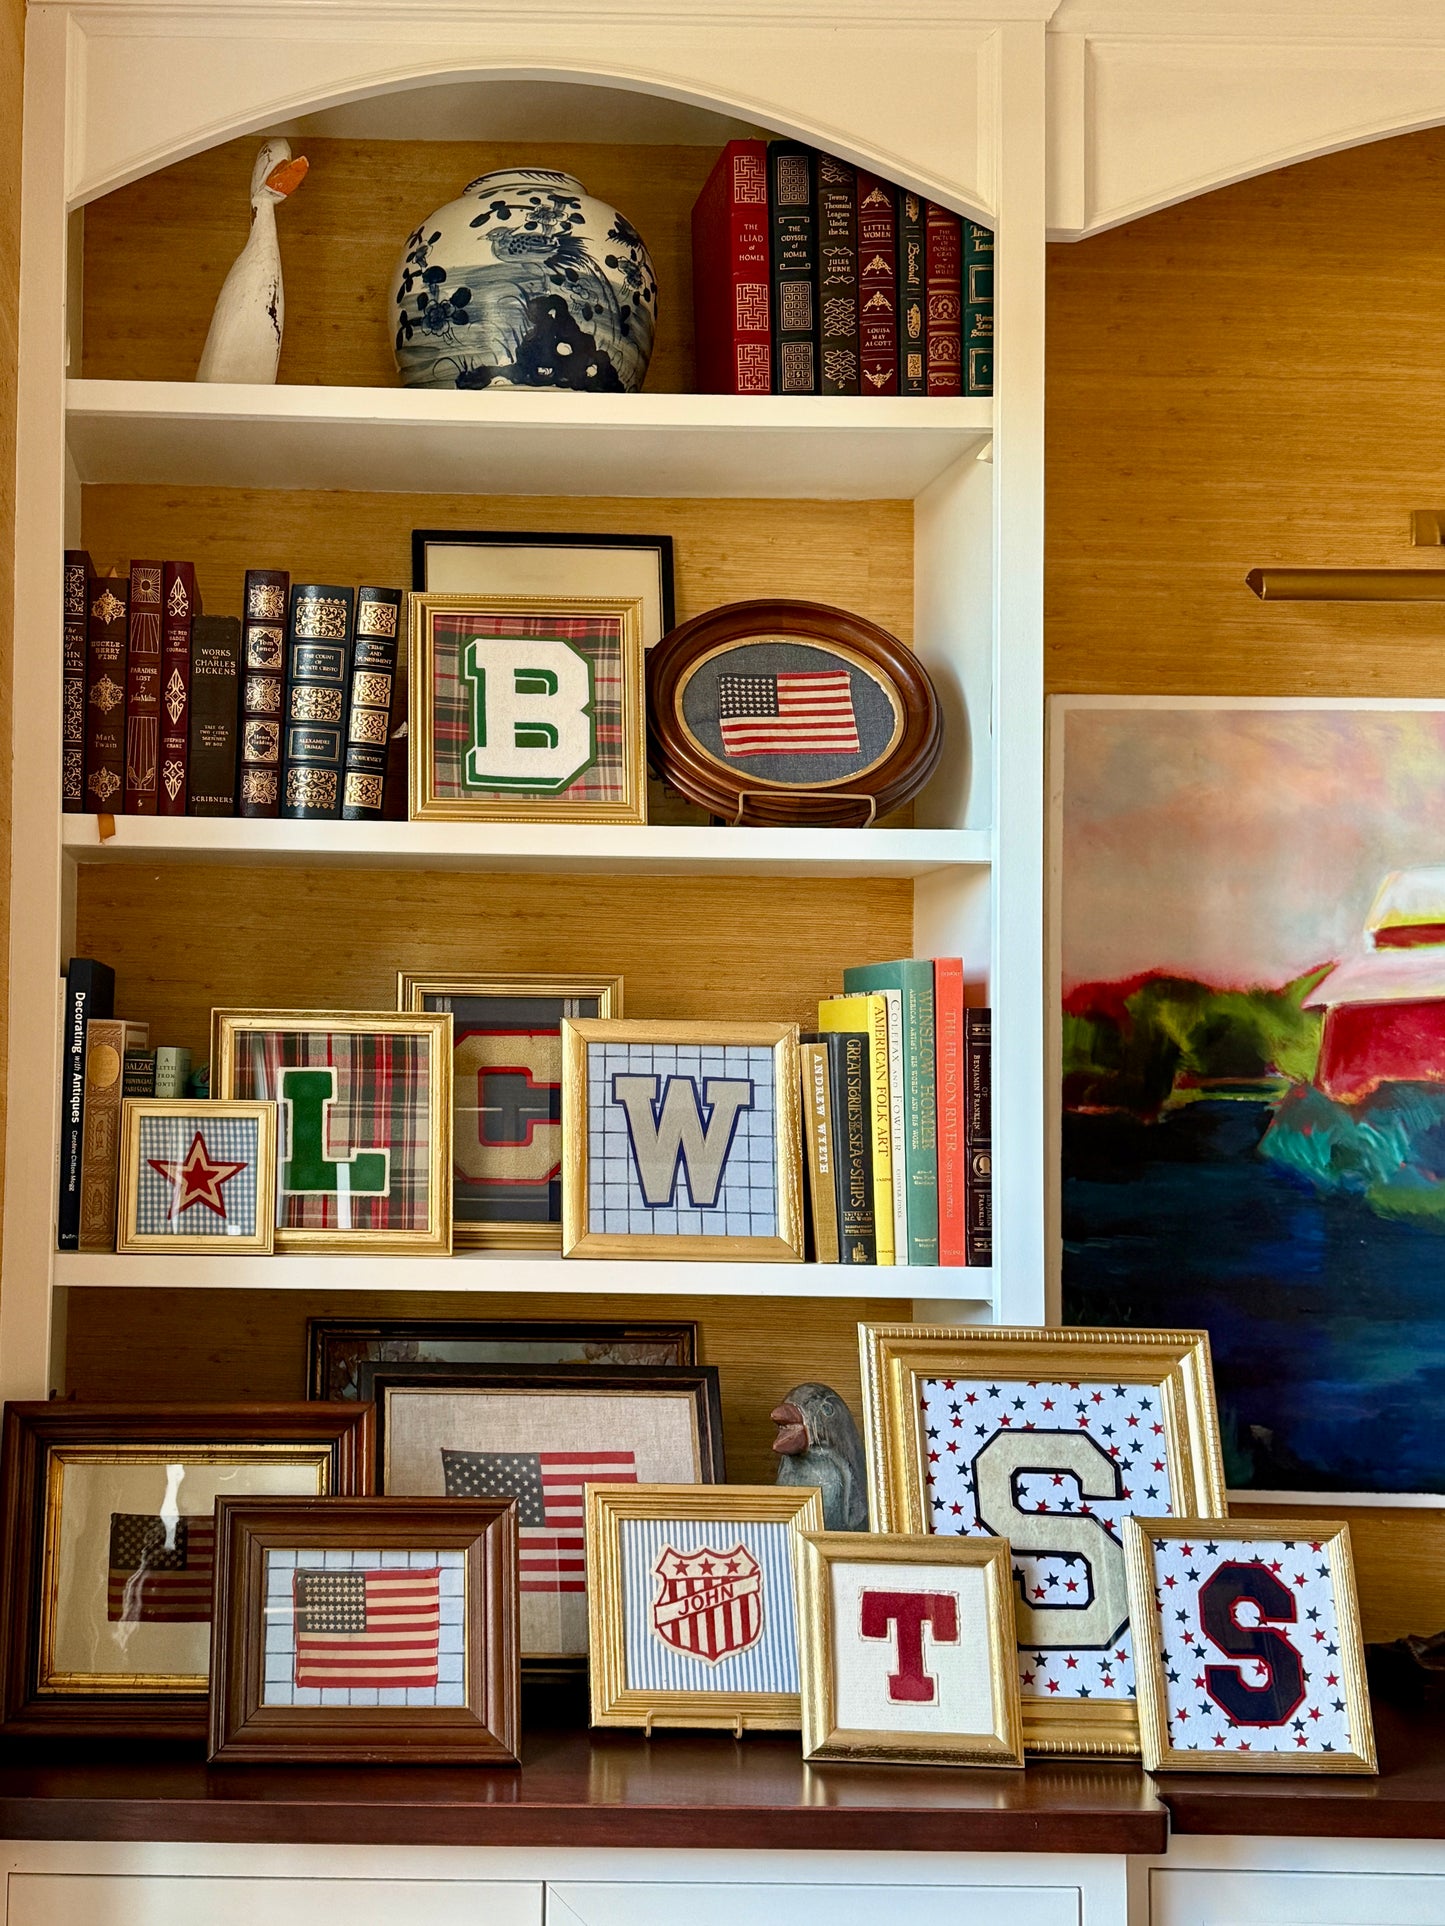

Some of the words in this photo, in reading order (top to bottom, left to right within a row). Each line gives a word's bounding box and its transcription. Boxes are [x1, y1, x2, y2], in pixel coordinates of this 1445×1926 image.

[827, 193, 848, 203] Twenty
[827, 210, 850, 219] Leagues
[739, 234, 764, 243] ILIAD
[743, 223, 759, 231] THE
[828, 227, 838, 236] the
[838, 227, 849, 236] Sea
[829, 219, 848, 227] Under
[863, 224, 892, 232] LITTLE
[863, 231, 891, 239] WOMEN
[739, 254, 765, 262] HOMER
[828, 258, 849, 266] JULES
[907, 241, 921, 285] Beowulf
[195, 658, 236, 668] CHARLES
[201, 648, 231, 657] WORKS
[256, 645, 275, 653] Jones
[130, 667, 158, 675] PARADISE
[195, 667, 236, 676] DICKENS
[460, 634, 596, 795] B
[95, 733, 116, 741] Mark
[95, 741, 118, 749] Twain
[191, 796, 234, 804] SCRIBNERS
[71, 992, 86, 1054] Decorating
[909, 989, 917, 1025] AMERICAN
[945, 1008, 957, 1036] THE
[874, 1006, 887, 1081] AMERICAN
[891, 999, 900, 1062] COLEFAX
[919, 987, 934, 1079] WINSLOW
[73, 1055, 82, 1072] with
[125, 1062, 153, 1071] BALZAC
[846, 1038, 861, 1078] GREAT
[945, 1041, 958, 1105] HUDSON
[973, 1054, 981, 1091] BENJAMIN
[69, 1073, 84, 1124] Antiques
[813, 1052, 826, 1117] ANDREW
[847, 1078, 863, 1121] STORIES
[981, 1086, 989, 1098] OF
[453, 1029, 561, 1186] C
[876, 1086, 888, 1122] FOLK
[911, 1114, 919, 1127] HIS
[921, 1084, 936, 1150] HOMER
[973, 1093, 981, 1130] FRANKLIN
[277, 1065, 390, 1198] L
[893, 1095, 903, 1151] FOWLER
[945, 1107, 958, 1152] RIVER
[611, 1072, 755, 1208] W
[817, 1121, 829, 1174] WYETH
[849, 1133, 864, 1159] SEA
[877, 1126, 889, 1158] ART
[852, 1158, 862, 1168] &
[850, 1168, 866, 1208] SHIPS
[971, 1427, 1130, 1651] S
[678, 1583, 734, 1616] JOHN
[858, 1585, 961, 1706] T
[1199, 1560, 1306, 1728] S
